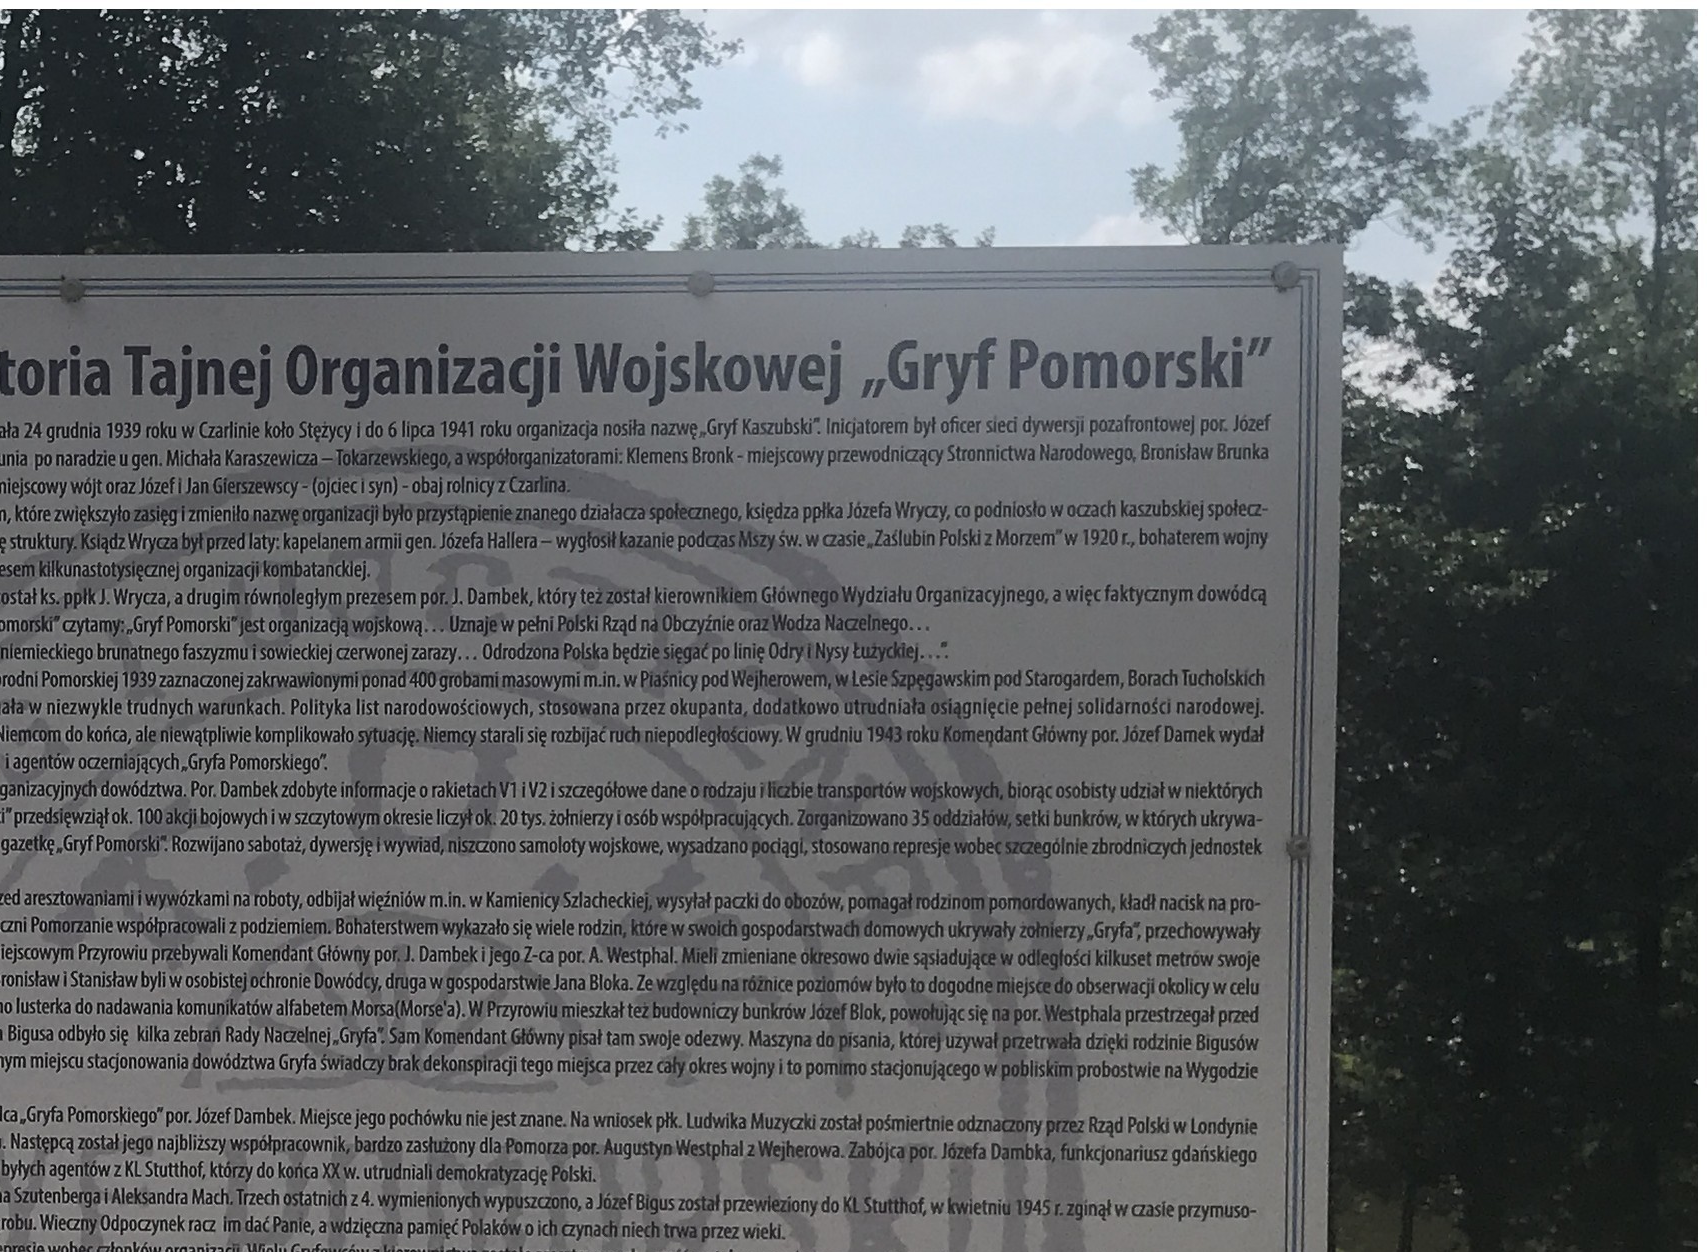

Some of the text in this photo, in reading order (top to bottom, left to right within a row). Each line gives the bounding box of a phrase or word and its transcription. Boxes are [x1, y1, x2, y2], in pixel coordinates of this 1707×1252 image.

[124, 344, 272, 409] Tajnej
[285, 343, 561, 409] Organizacji
[574, 340, 843, 405] Wojskowej
[23, 421, 43, 439] 24
[45, 420, 101, 443] grudnia
[106, 421, 142, 439] 1939
[145, 420, 177, 439] roku
[180, 424, 195, 439] w
[198, 420, 260, 439] Czarlinie
[264, 420, 295, 439] koło
[298, 420, 352, 442] Stężycy
[356, 421, 361, 439] i
[364, 419, 384, 438] do
[387, 420, 398, 438] 6
[401, 419, 435, 442] lipca
[440, 420, 474, 438] 1941
[480, 419, 512, 438] roku
[515, 419, 598, 442] organizacja
[602, 418, 646, 437] nosiła
[650, 418, 698, 441] nazwę
[826, 416, 908, 439] Inicjatorem
[913, 415, 936, 439] był
[940, 415, 982, 434] oficer
[985, 415, 1018, 434] sieci
[1021, 414, 1084, 437] dywersji
[1088, 413, 1195, 437] pozafrontowej
[1200, 418, 1228, 436] por.
[1232, 413, 1272, 432] Józef
[28, 701, 42, 720] w
[46, 696, 122, 720] niezwykle
[126, 696, 193, 720] trudnych
[197, 697, 286, 716] warunkach.
[290, 697, 351, 720] Polityka
[355, 697, 380, 716] list
[383, 697, 534, 720] narodowościowych,
[538, 699, 620, 716] stosowana
[624, 701, 666, 719] przez
[669, 696, 748, 720] okupanta,
[752, 696, 839, 715] dodatkowo
[843, 696, 925, 715] utrudniała
[930, 697, 1019, 719] osiągnięcie
[1022, 696, 1072, 719] pełnej
[1076, 696, 1171, 715] solidarności
[1175, 696, 1264, 719] narodowej.
[4, 752, 10, 769] i
[12, 752, 75, 775] agentów
[77, 751, 180, 775] oczerniających
[0, 1158, 46, 1181] byłych
[48, 1159, 111, 1182] agentów
[112, 1164, 122, 1178] z
[124, 1159, 142, 1178] KL
[144, 1159, 206, 1180] Stutthof,
[209, 1160, 254, 1183] którzy
[256, 1160, 275, 1179] do
[277, 1161, 318, 1180] końca
[321, 1162, 340, 1179] XX
[342, 1166, 360, 1180] w.
[362, 1162, 432, 1181] utrudniali
[435, 1163, 548, 1186] demokratyzację
[551, 1164, 596, 1182] Polski.
